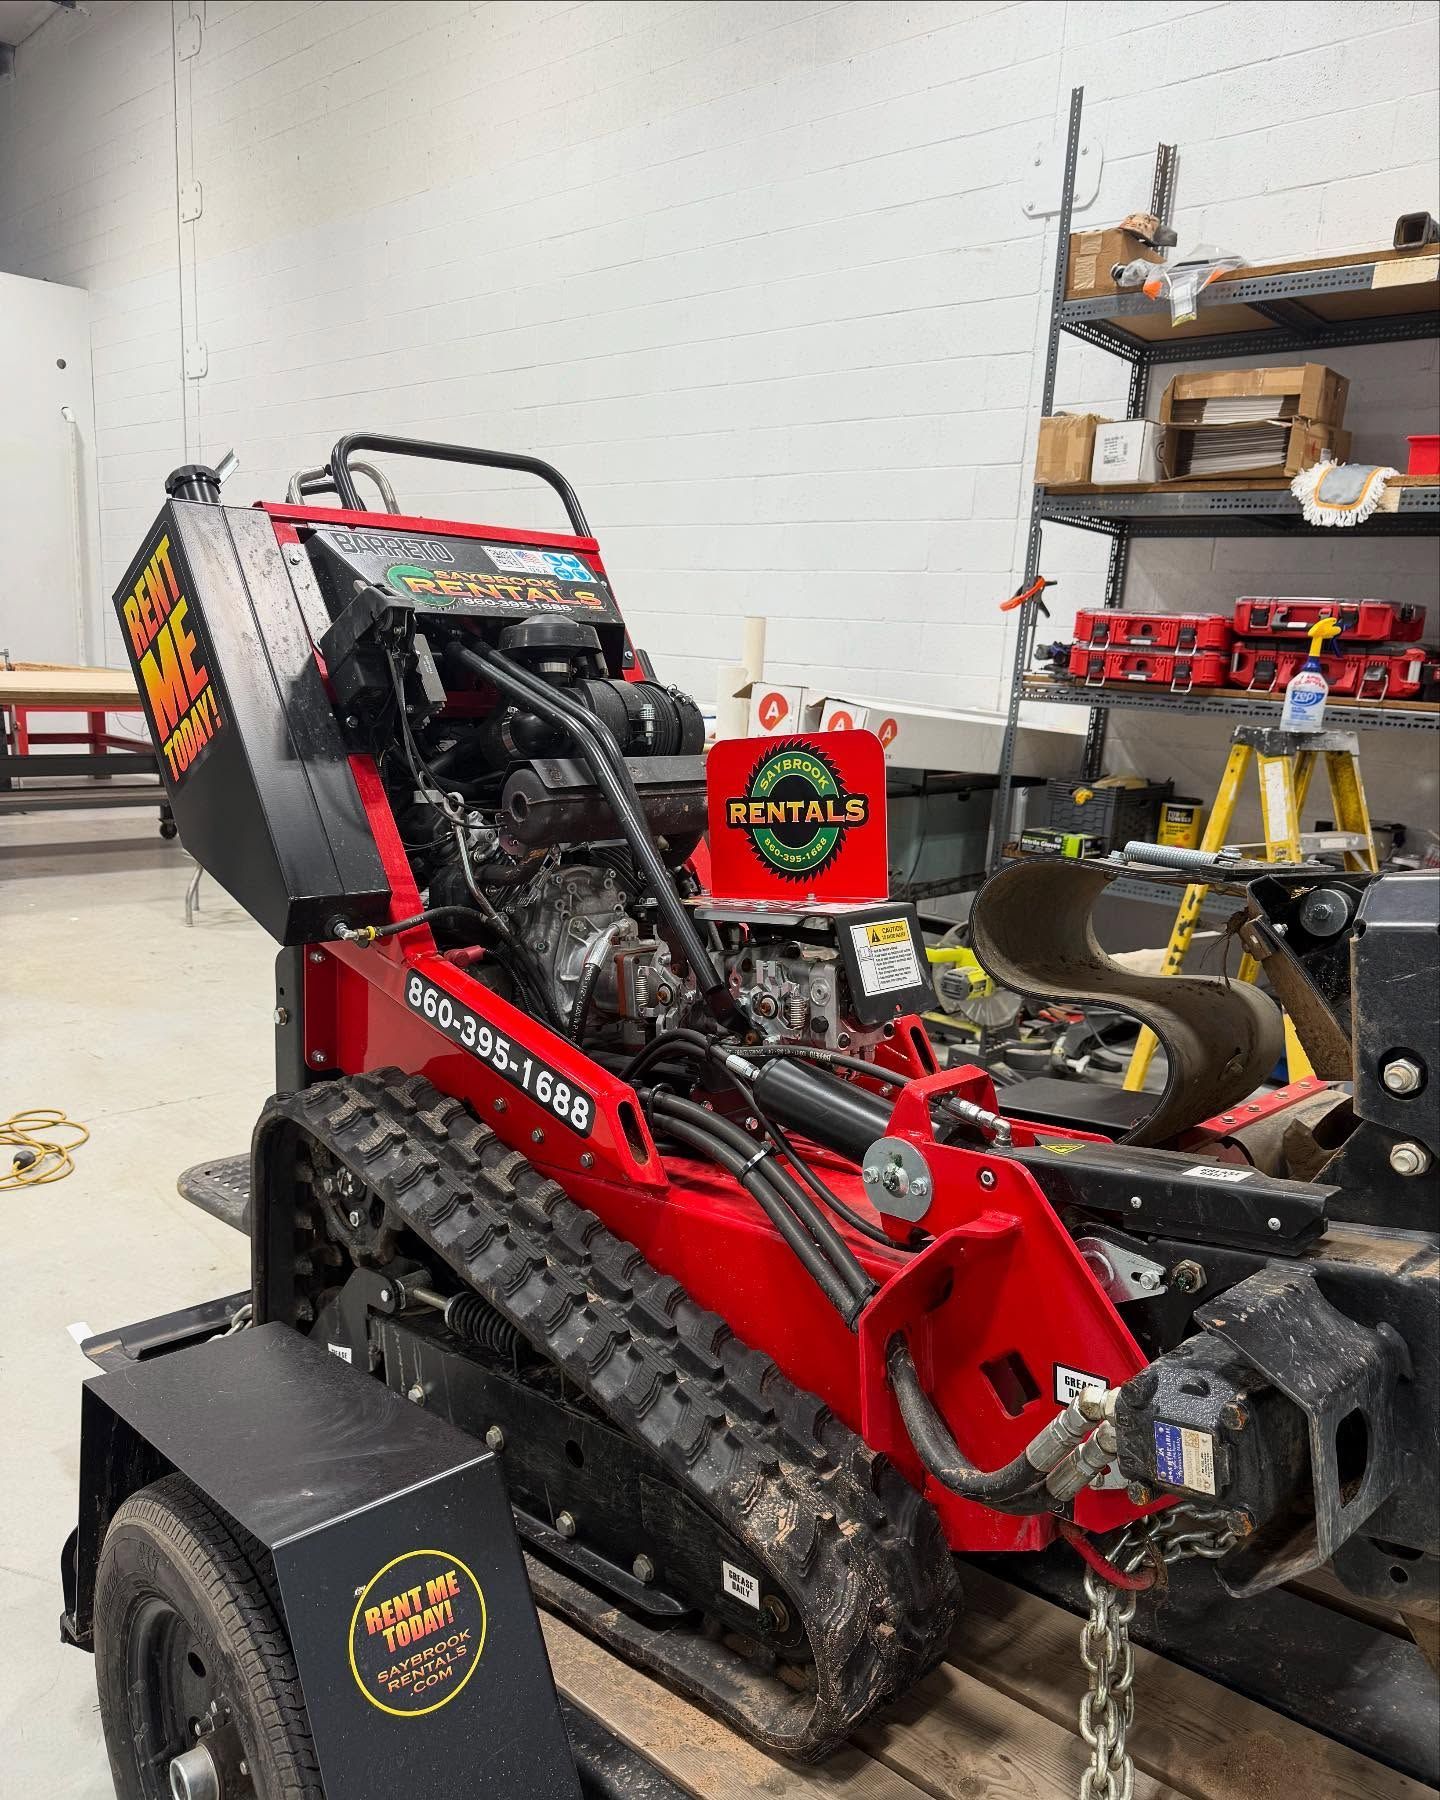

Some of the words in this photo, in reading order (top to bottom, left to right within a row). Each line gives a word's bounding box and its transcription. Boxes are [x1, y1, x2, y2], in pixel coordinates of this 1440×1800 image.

[329, 531, 455, 562] BARRETO
[402, 577, 602, 606] RENTALS
[434, 570, 560, 588] SAYBROOK
[123, 534, 180, 660] RENT
[462, 597, 573, 612] 860-395-1688
[140, 595, 209, 743] ME
[164, 685, 222, 782] TODAY!
[760, 758, 830, 791] SAYBROOK
[730, 799, 865, 824] RENTALS
[764, 838, 827, 863] 860-395-1688
[1022, 838, 1040, 846] Nitrile
[1041, 841, 1060, 849] Gloves
[882, 925, 903, 934] CAUTION
[408, 976, 590, 1131] 860-395-1688
[728, 1569, 754, 1591] GREASE
[731, 1581, 750, 1597] DAILY
[364, 1586, 422, 1635] RENT
[426, 1569, 460, 1605] ME
[382, 1600, 454, 1653] TODAY!
[377, 1628, 471, 1683] SAYBROOK
[387, 1645, 467, 1693] RENTALS
[410, 1666, 453, 1696] .COM
